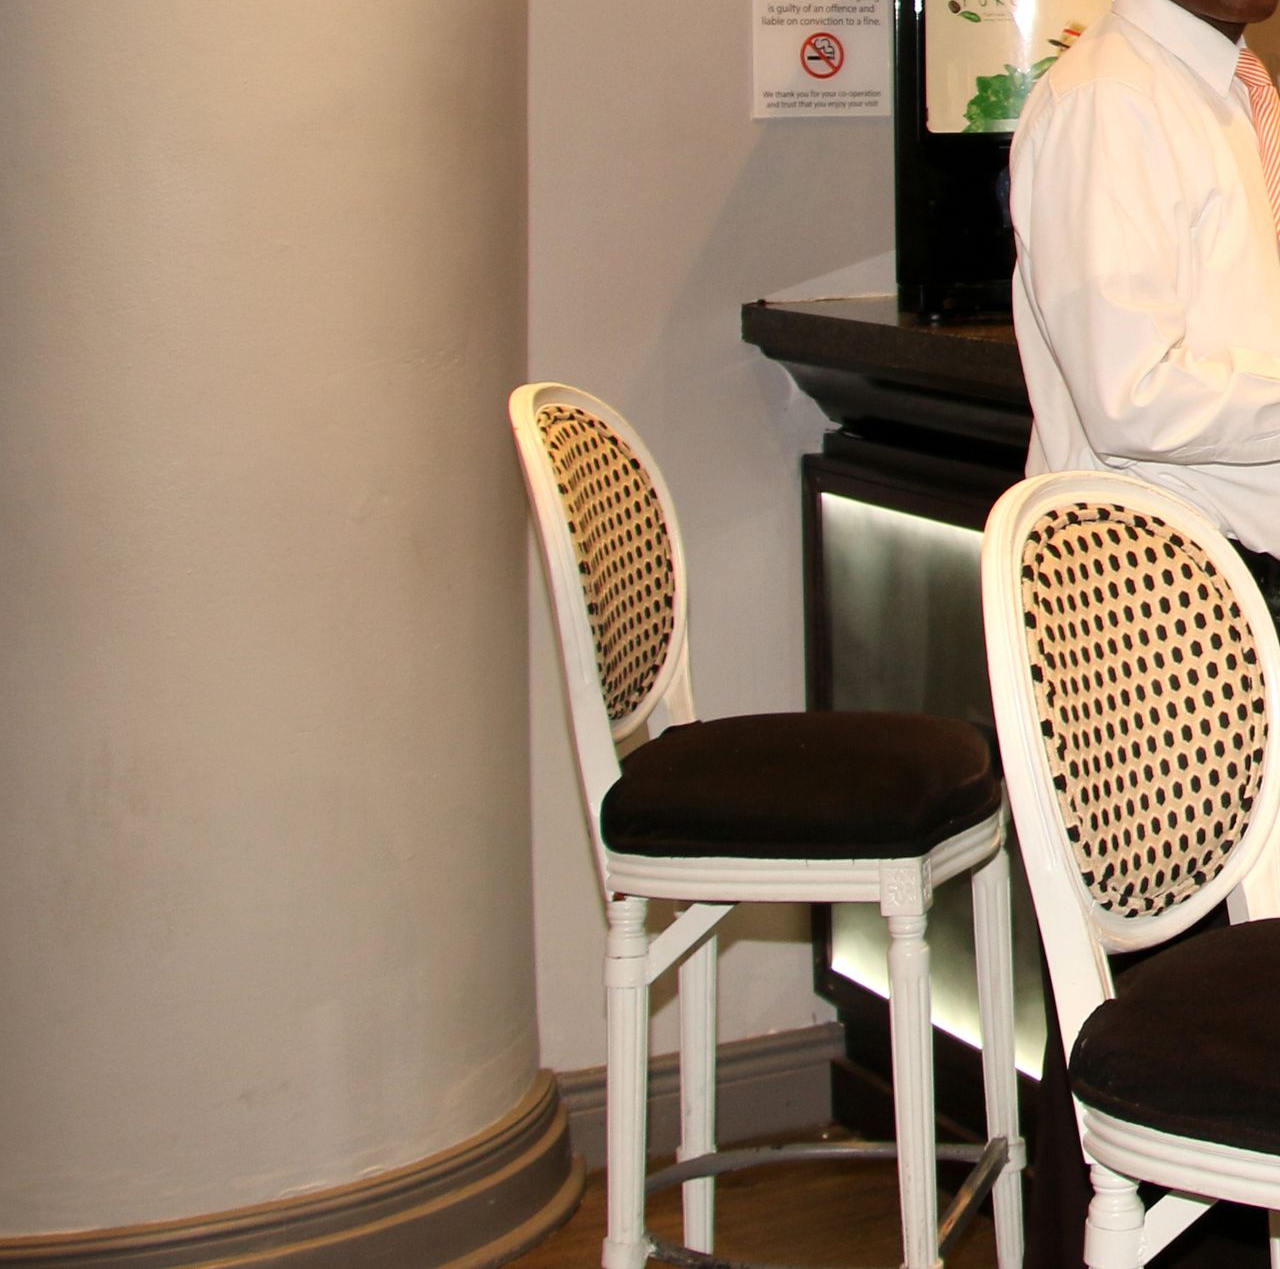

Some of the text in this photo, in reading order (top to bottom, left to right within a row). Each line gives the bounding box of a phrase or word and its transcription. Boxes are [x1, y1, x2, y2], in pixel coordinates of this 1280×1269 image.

[768, 4, 775, 12] is
[776, 4, 800, 15] guilty
[803, 4, 812, 13] of
[826, 5, 857, 13] offence
[859, 5, 874, 13] and
[761, 17, 785, 26] liable
[786, 18, 797, 26] on
[800, 17, 844, 26] conviction
[846, 18, 855, 26] to
[796, 91, 809, 99] you
[838, 90, 881, 98] co-operation
